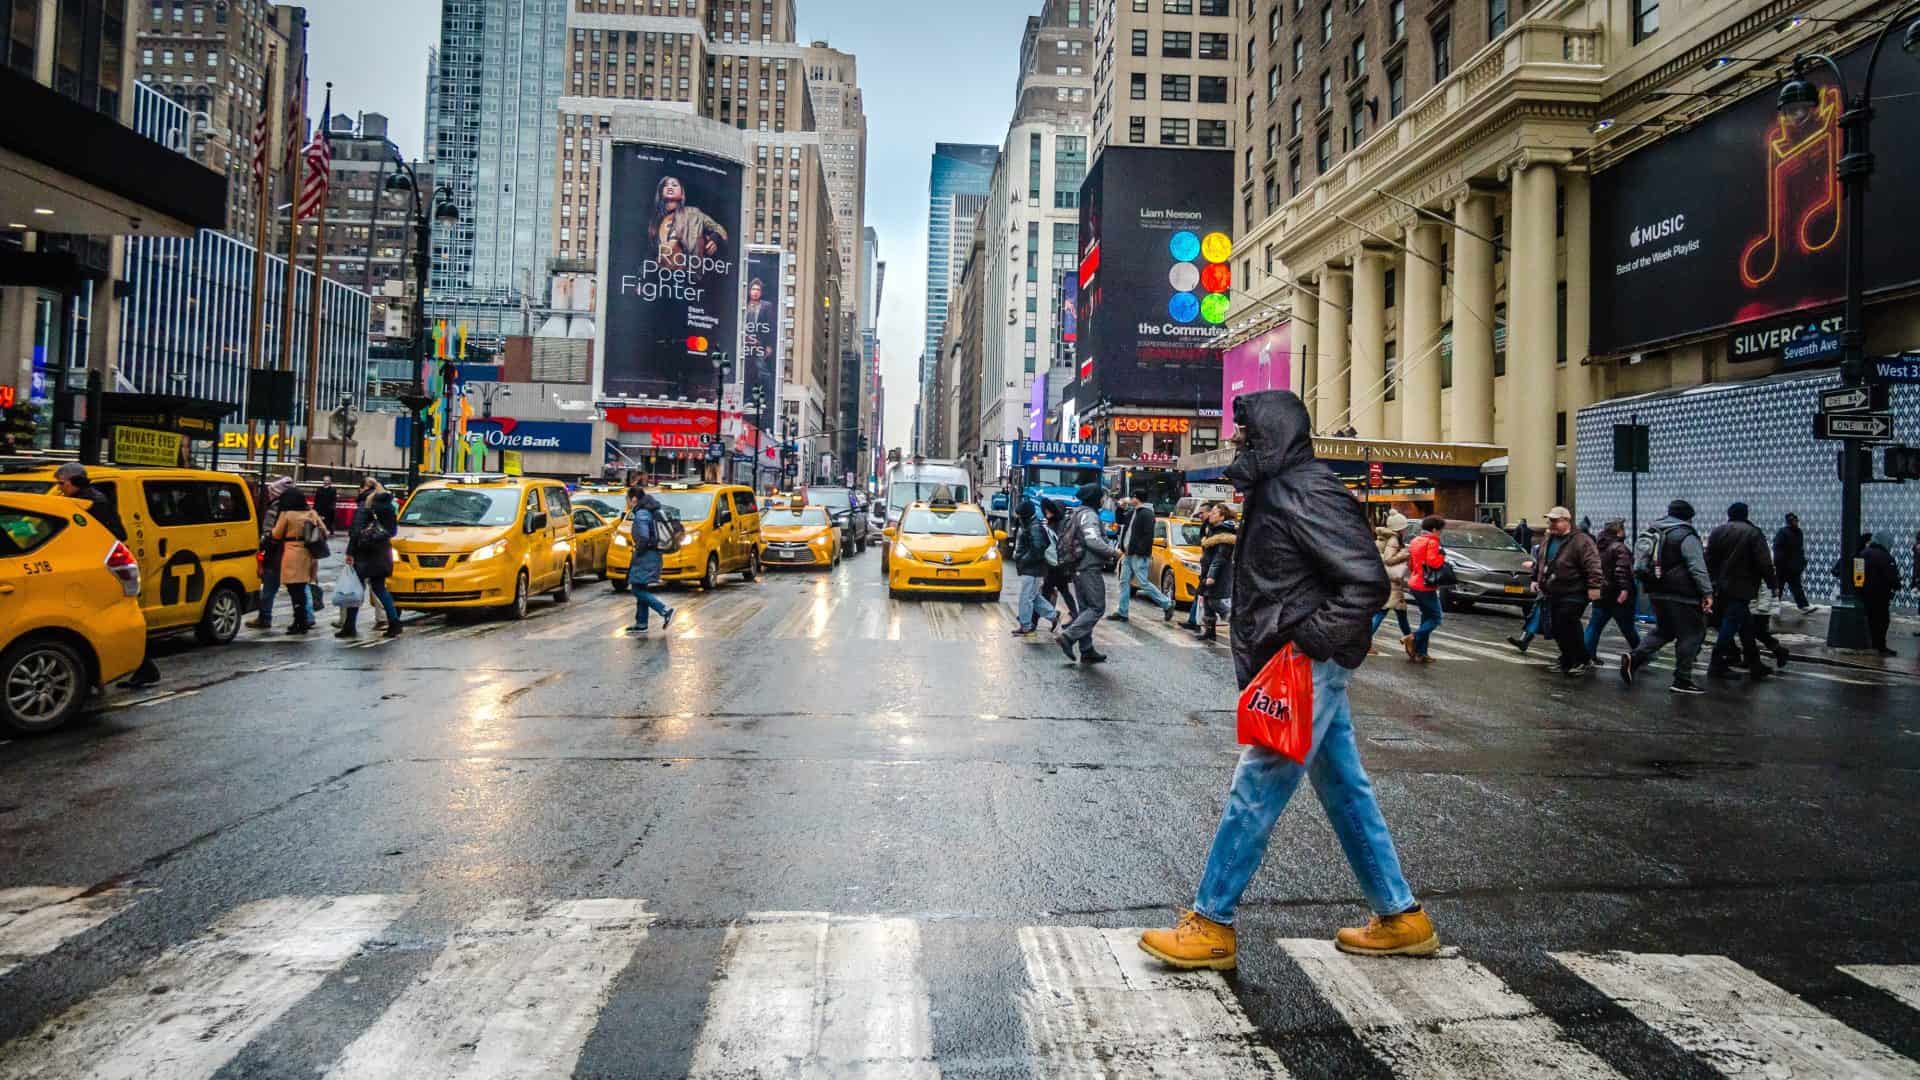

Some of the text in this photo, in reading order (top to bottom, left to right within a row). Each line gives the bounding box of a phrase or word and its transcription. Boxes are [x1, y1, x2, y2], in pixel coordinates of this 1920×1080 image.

[1140, 208, 1202, 220] Liam Neeson
[1641, 214, 1684, 244] MUSIC
[658, 244, 732, 276] Rapper
[1616, 240, 1700, 275] Best of the Week Playlist
[642, 259, 697, 285] Poet
[621, 275, 705, 303] Fighter
[1138, 323, 1161, 335] the
[1735, 316, 1843, 355] SILVERCST
[1784, 339, 1838, 360] Seventh Ave
[1876, 363, 1920, 377] West 3
[1113, 415, 1190, 433] HOOTERS
[118, 429, 157, 447] PRIVATE
[522, 436, 560, 447] Bank
[1070, 444, 1100, 456] CORP.
